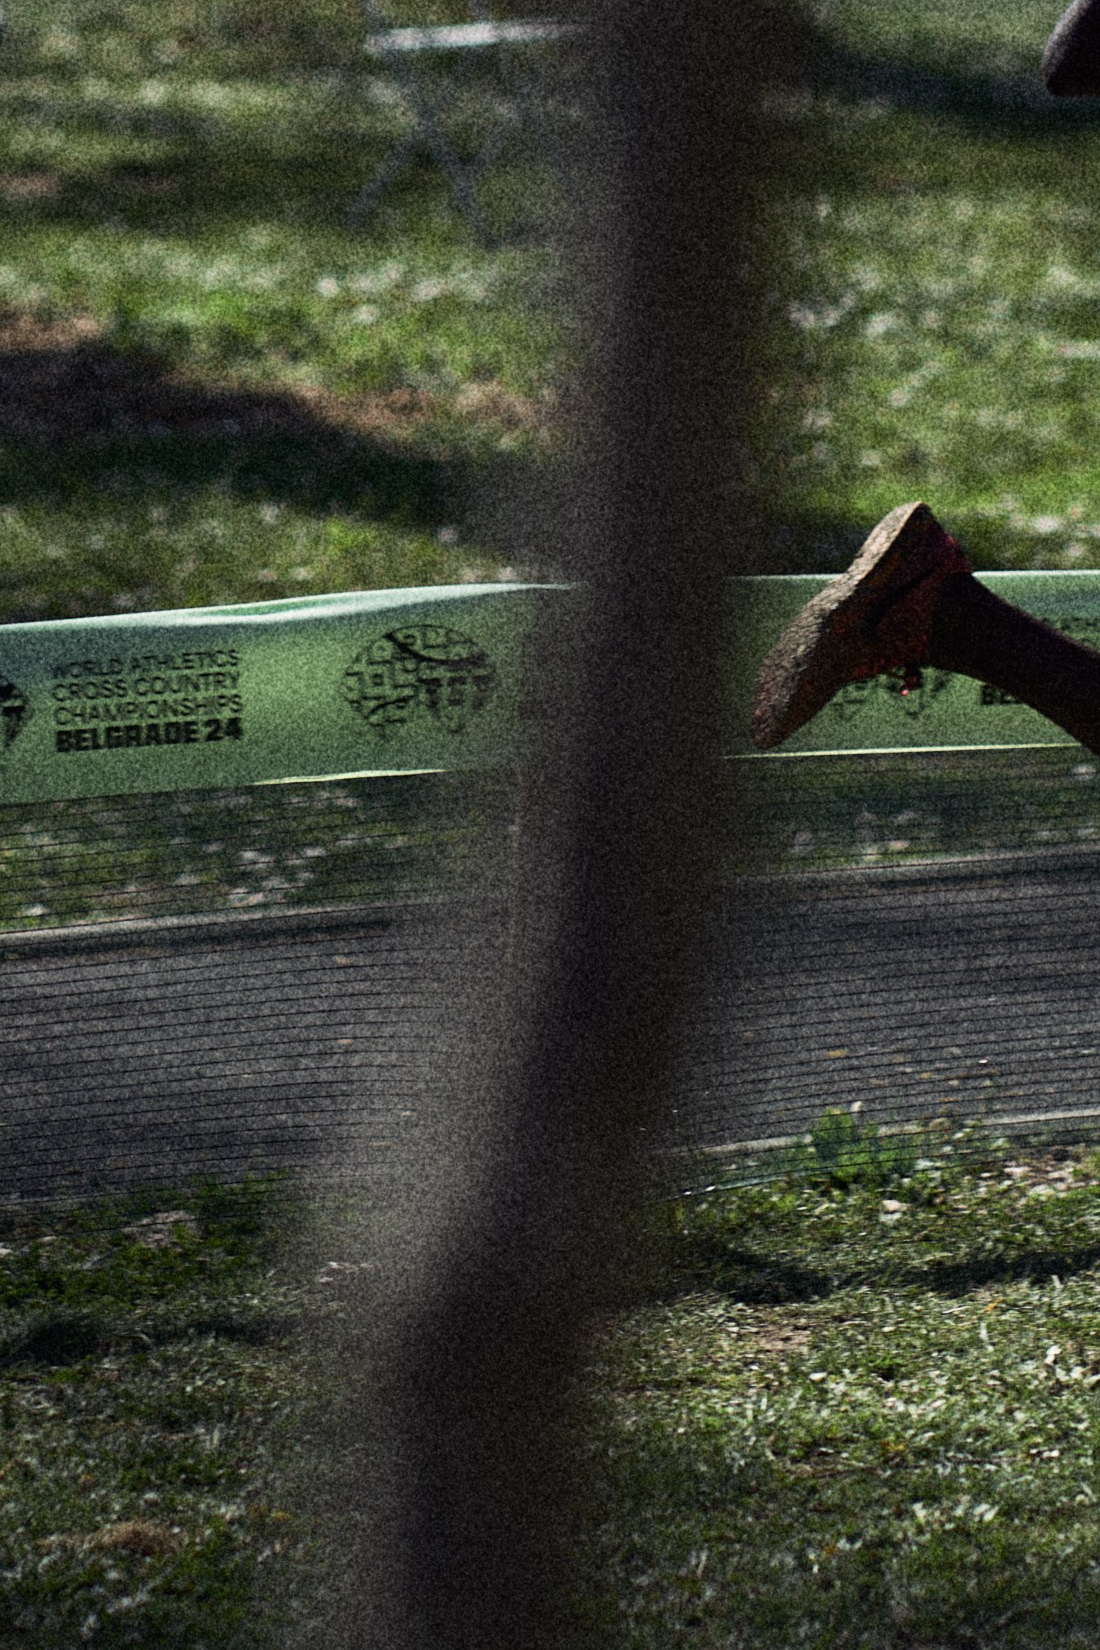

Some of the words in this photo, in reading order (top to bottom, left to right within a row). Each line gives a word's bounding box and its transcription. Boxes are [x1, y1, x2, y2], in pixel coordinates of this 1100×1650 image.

[53, 658, 122, 679] WORLD
[129, 648, 241, 671] ATHLETICS
[52, 679, 128, 702] CROSS
[134, 671, 242, 696] COUNTRY
[53, 694, 243, 725] CHAMPIONSHIPS
[55, 720, 200, 753] BELGRADE
[204, 716, 244, 743] 24
